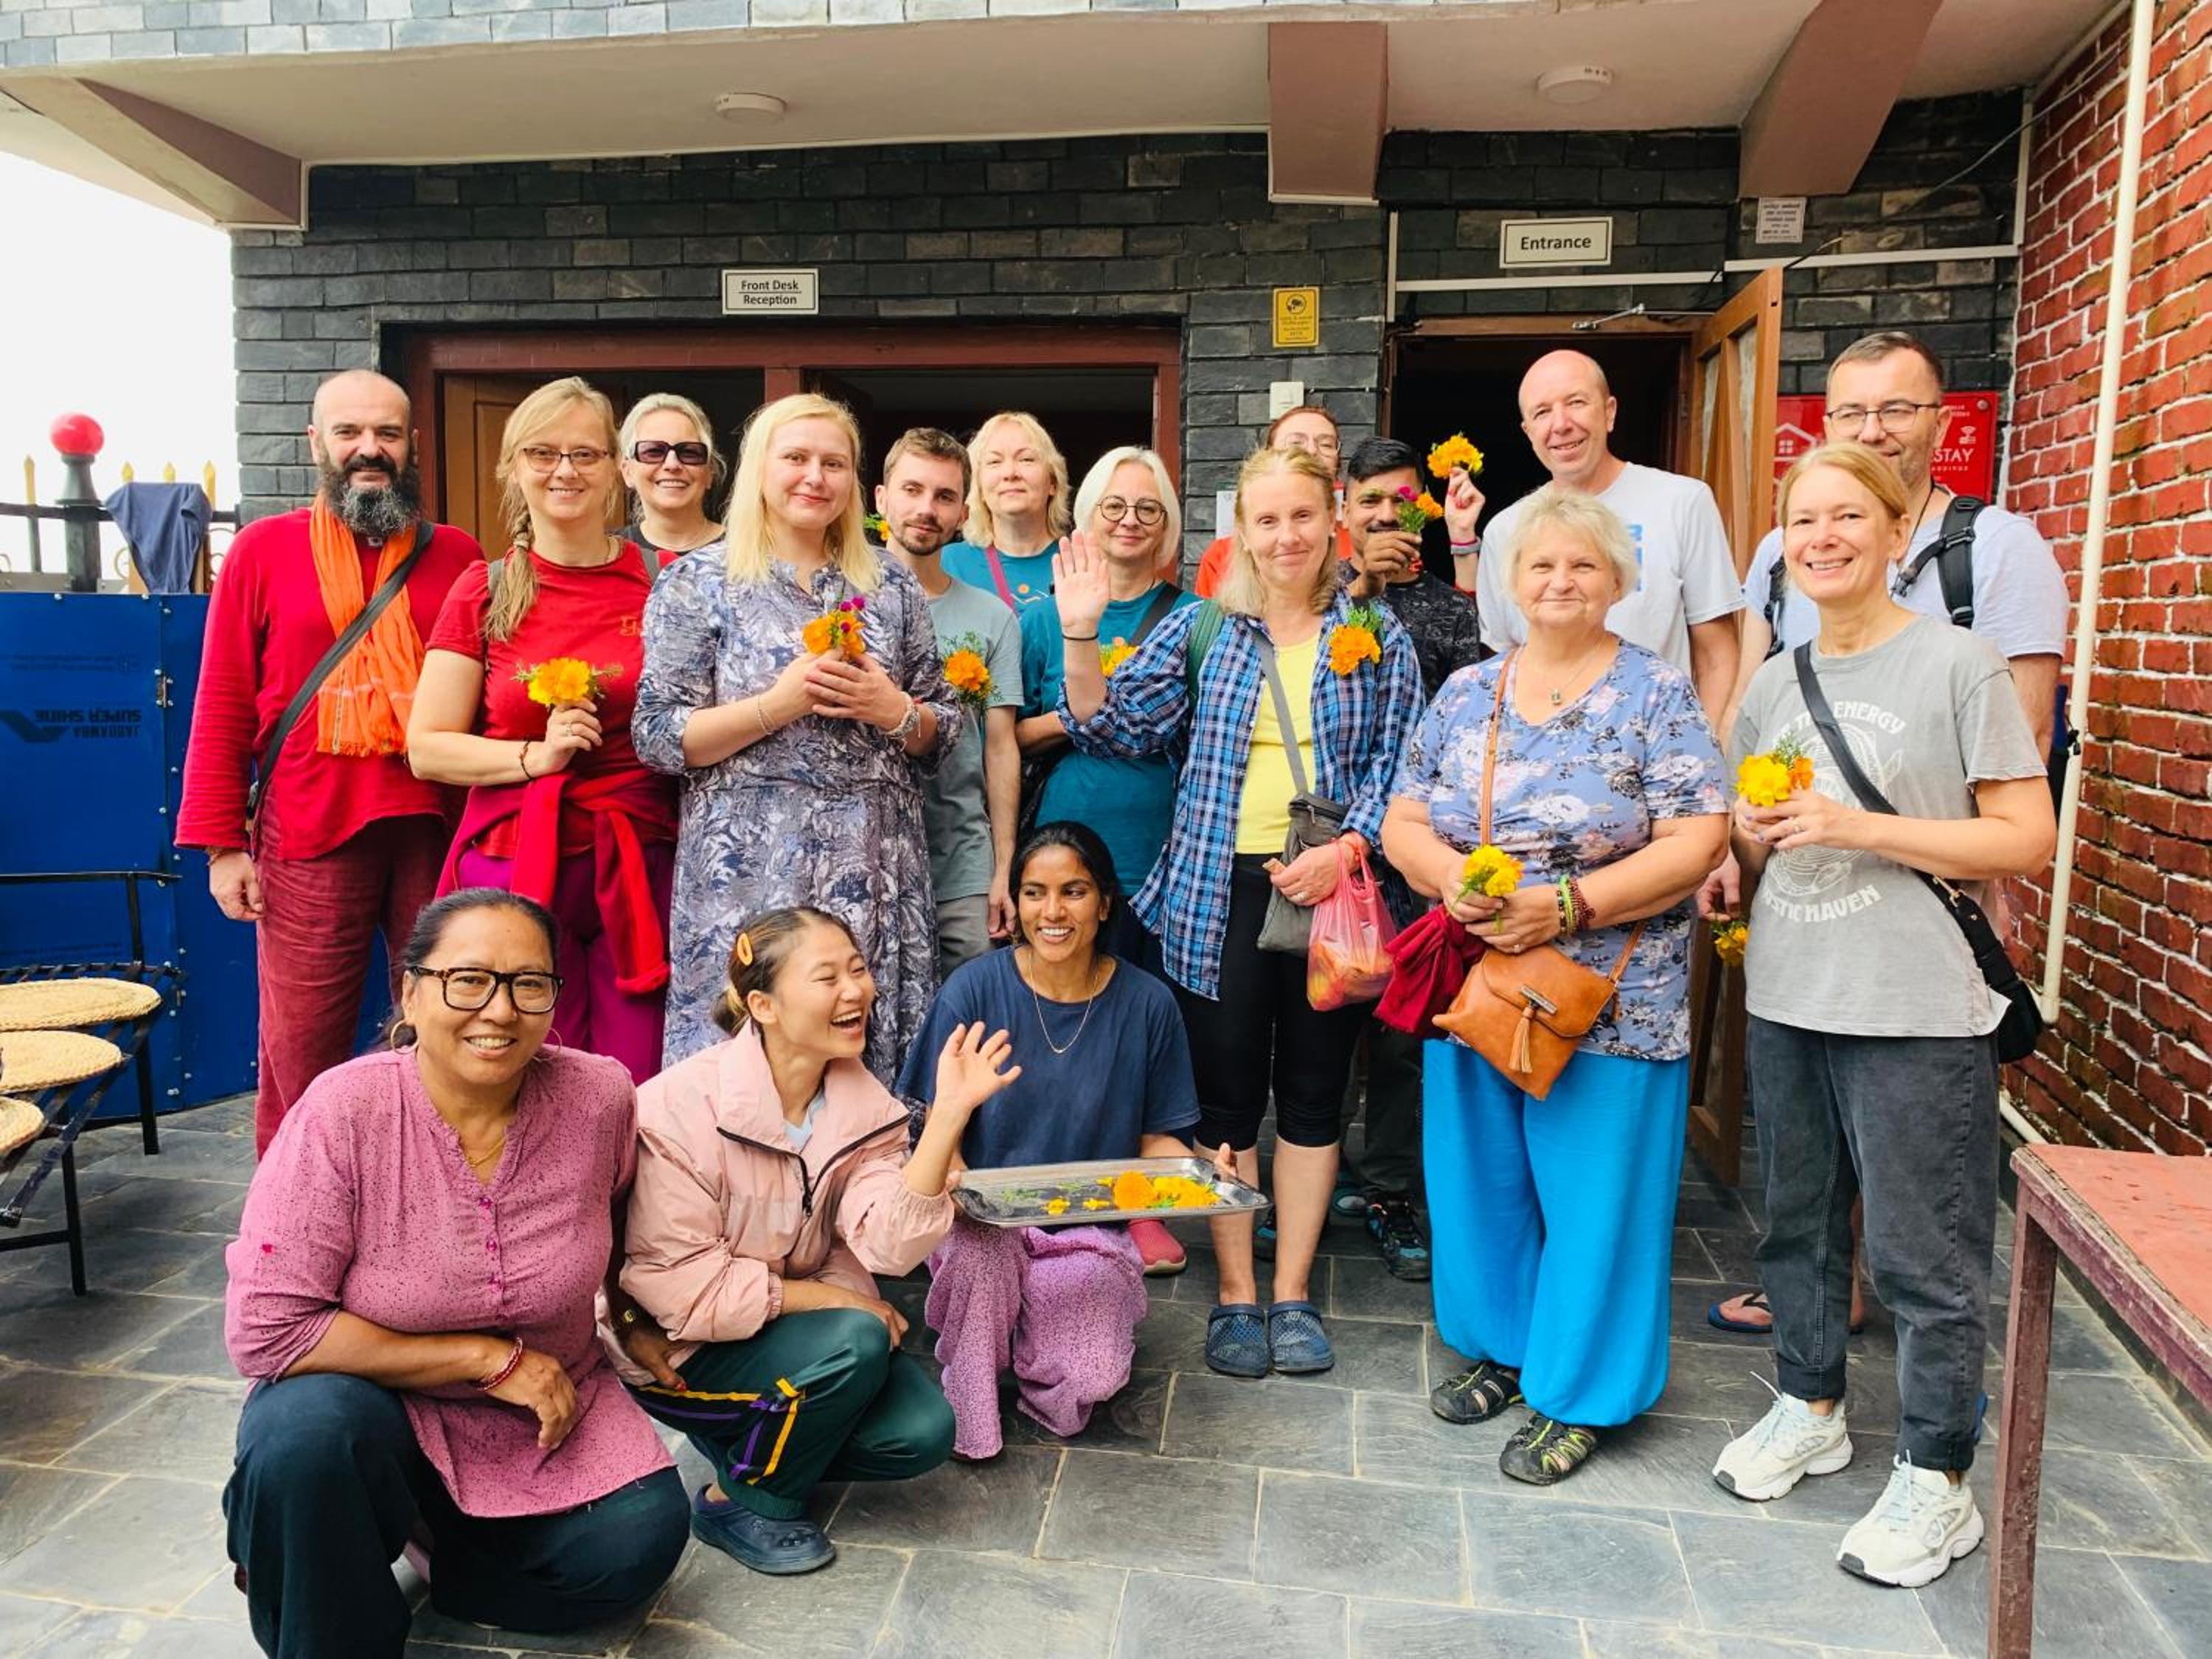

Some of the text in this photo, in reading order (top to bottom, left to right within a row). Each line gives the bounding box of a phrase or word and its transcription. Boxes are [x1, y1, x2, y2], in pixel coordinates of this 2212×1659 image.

[1521, 237, 1591, 250] Entrance
[741, 279, 799, 290] Front Desk
[743, 295, 797, 307] Reception
[35, 709, 142, 723] SUPER SHINE
[1833, 700, 1907, 734] ENERGY
[1804, 884, 1882, 922] HAVEN
